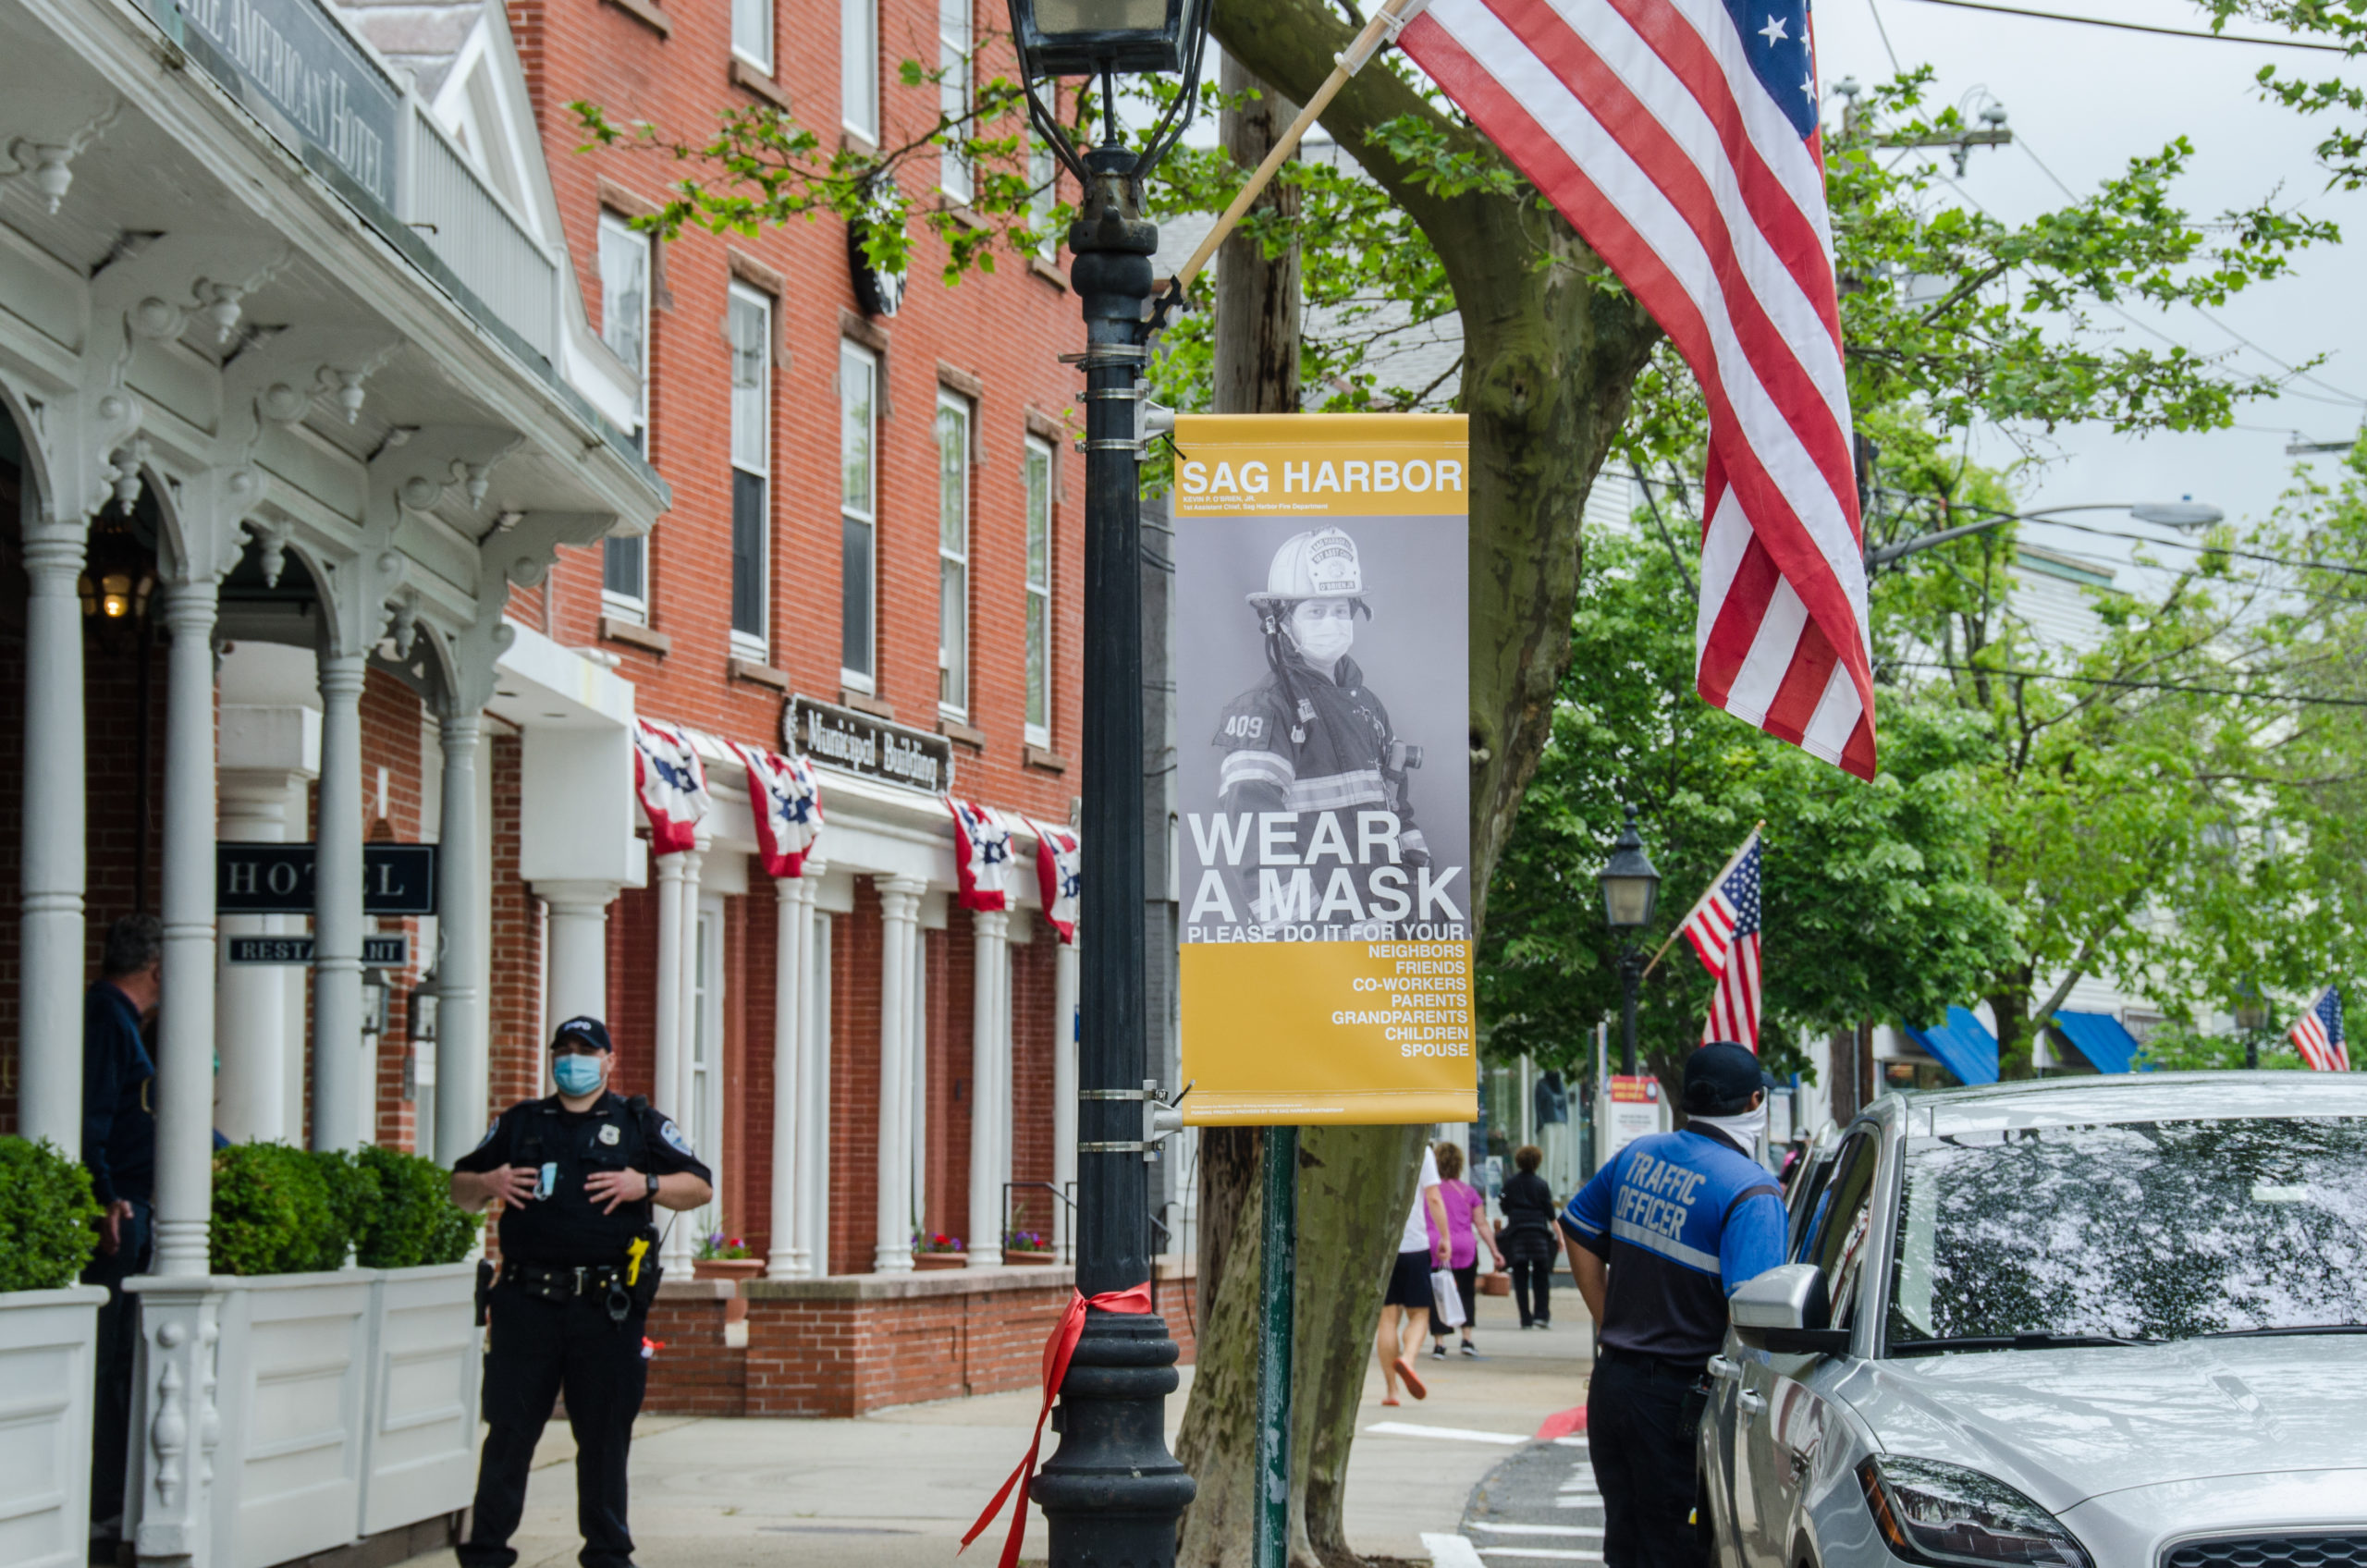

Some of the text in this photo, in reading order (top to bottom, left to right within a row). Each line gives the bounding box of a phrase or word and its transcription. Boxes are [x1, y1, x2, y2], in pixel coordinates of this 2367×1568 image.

[227, 0, 386, 203] AMERICAN HOTEL
[1183, 459, 1463, 495] SAG HARBOR
[1243, 503, 1255, 511] Sag
[1293, 502, 1328, 511] Department
[1224, 715, 1264, 739] 409
[808, 709, 938, 791] Municipal Building
[1187, 811, 1403, 865] WEAR
[227, 862, 405, 896] HOL
[1187, 866, 1465, 923] A MASK
[1188, 923, 1465, 943] PLEASE DO IT FOR YOUR
[241, 941, 399, 961] RESTNT
[1368, 944, 1466, 958] NEIGHBORS
[1396, 961, 1466, 974] FRIENDS
[1353, 977, 1466, 992] CO-WORKERS
[1392, 994, 1467, 1008] PARENTS
[1331, 1010, 1468, 1024] GRANDPARENTS
[1385, 1026, 1469, 1041] CHILDREN
[1401, 1043, 1469, 1058] SPOUSE
[1625, 1151, 1707, 1206] TRAFFIC
[1615, 1184, 1687, 1242] OFFICER
